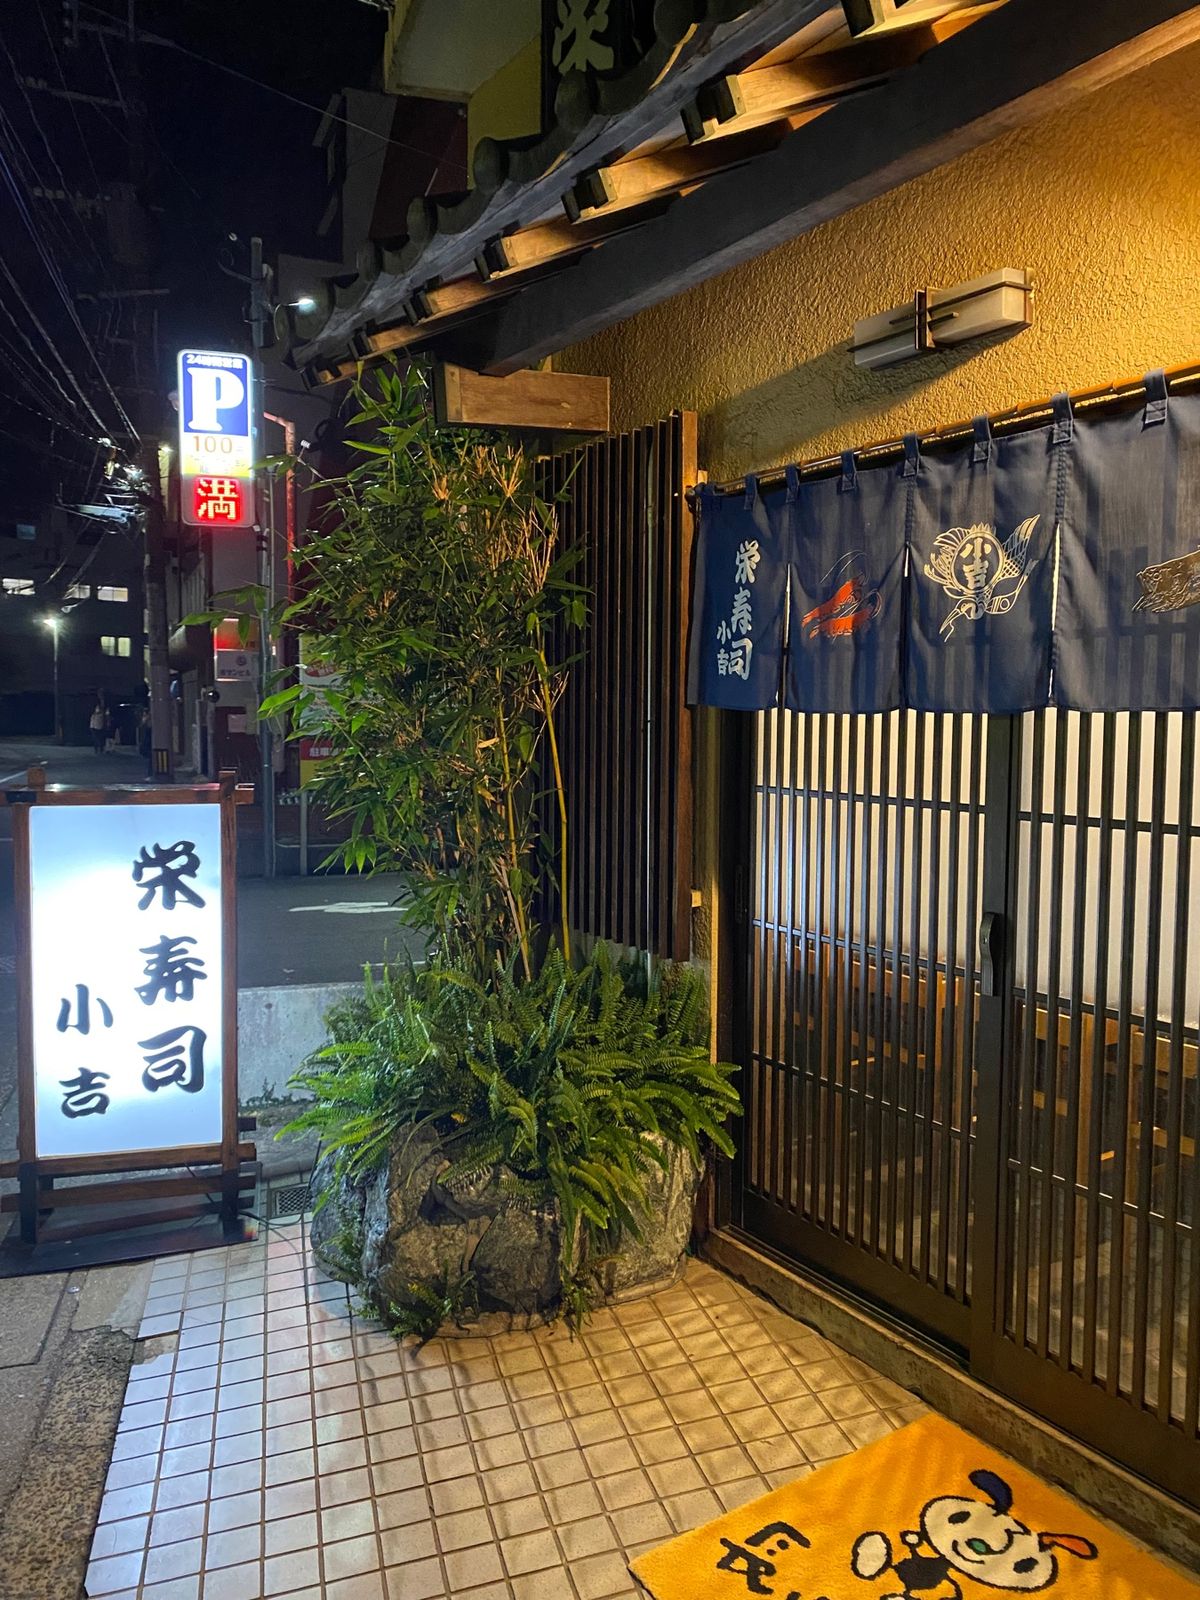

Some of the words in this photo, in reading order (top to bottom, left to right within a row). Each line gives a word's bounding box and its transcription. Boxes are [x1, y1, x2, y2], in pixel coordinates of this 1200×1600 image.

[187, 366, 245, 432] P
[193, 435, 233, 454] 100
[197, 479, 239, 520] 満
[960, 538, 992, 590] 小吉
[728, 539, 761, 681] 栄寿司
[132, 840, 208, 1094] 栄寿司
[56, 983, 114, 1119] 小吉
